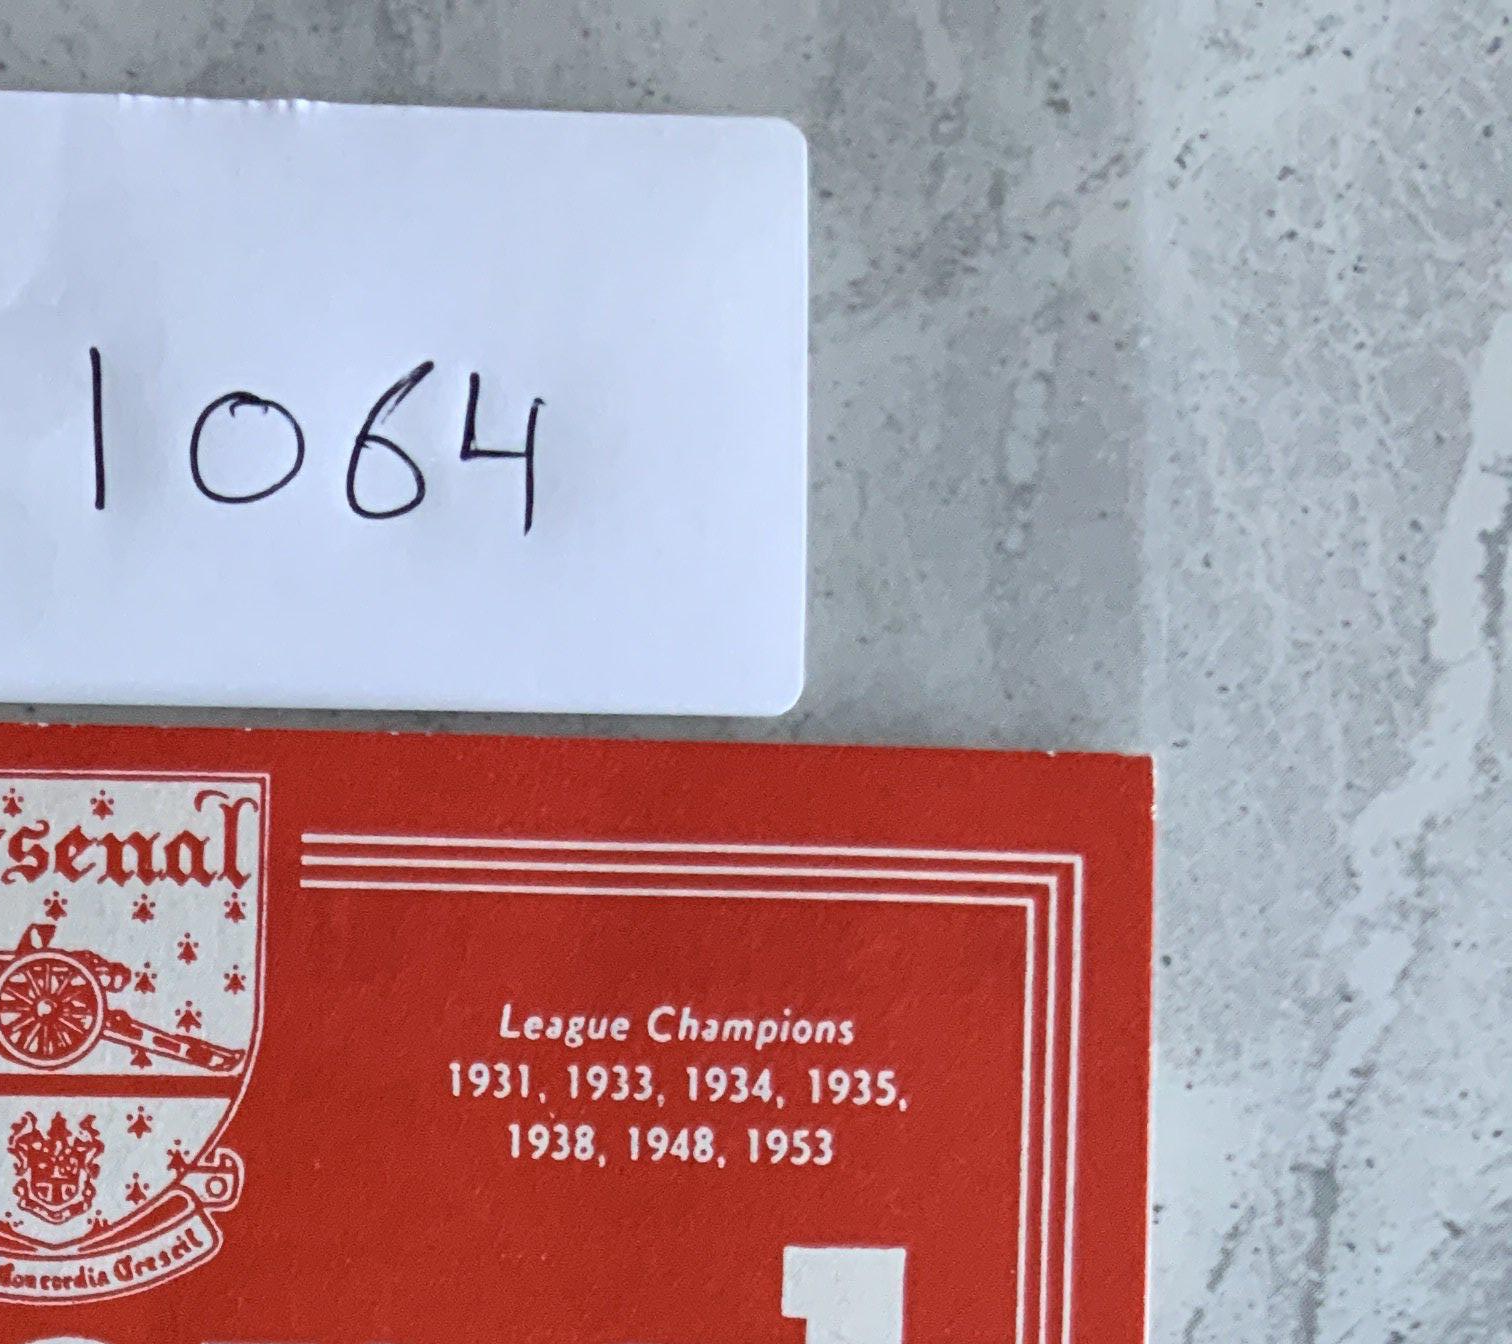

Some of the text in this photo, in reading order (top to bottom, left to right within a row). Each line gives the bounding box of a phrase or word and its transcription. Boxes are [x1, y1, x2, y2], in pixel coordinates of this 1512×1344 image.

[89, 346, 545, 535] 1064
[499, 1003, 854, 1051] League Champions
[449, 1062, 908, 1112] 1931, 1933, 1934, 1935,
[508, 1123, 834, 1169] 1938, 1948, 1953
